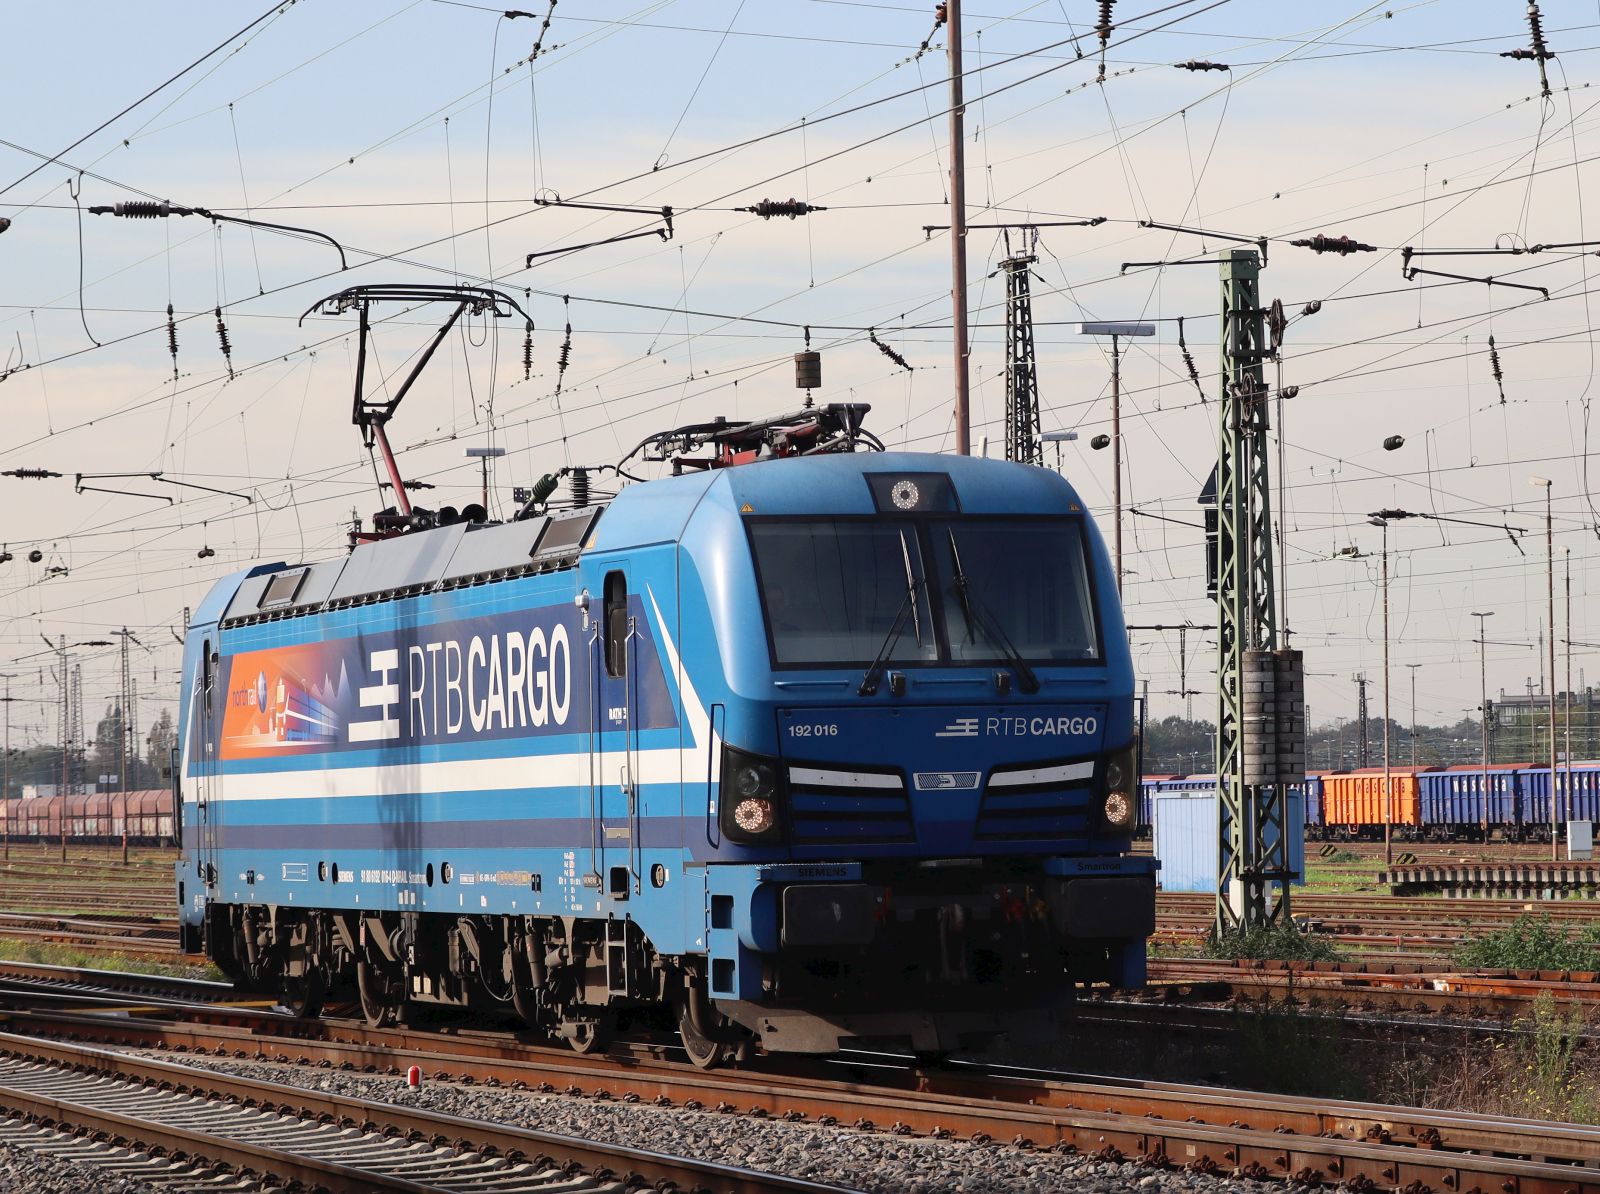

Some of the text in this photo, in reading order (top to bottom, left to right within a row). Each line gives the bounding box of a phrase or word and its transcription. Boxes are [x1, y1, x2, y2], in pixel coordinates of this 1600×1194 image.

[467, 623, 571, 734] CARGO
[232, 678, 257, 707] northrail
[788, 724, 838, 737] 192 016
[986, 717, 1097, 736] RTB CARGO
[798, 867, 847, 877] SIEMENS
[1077, 862, 1121, 871] Smartron
